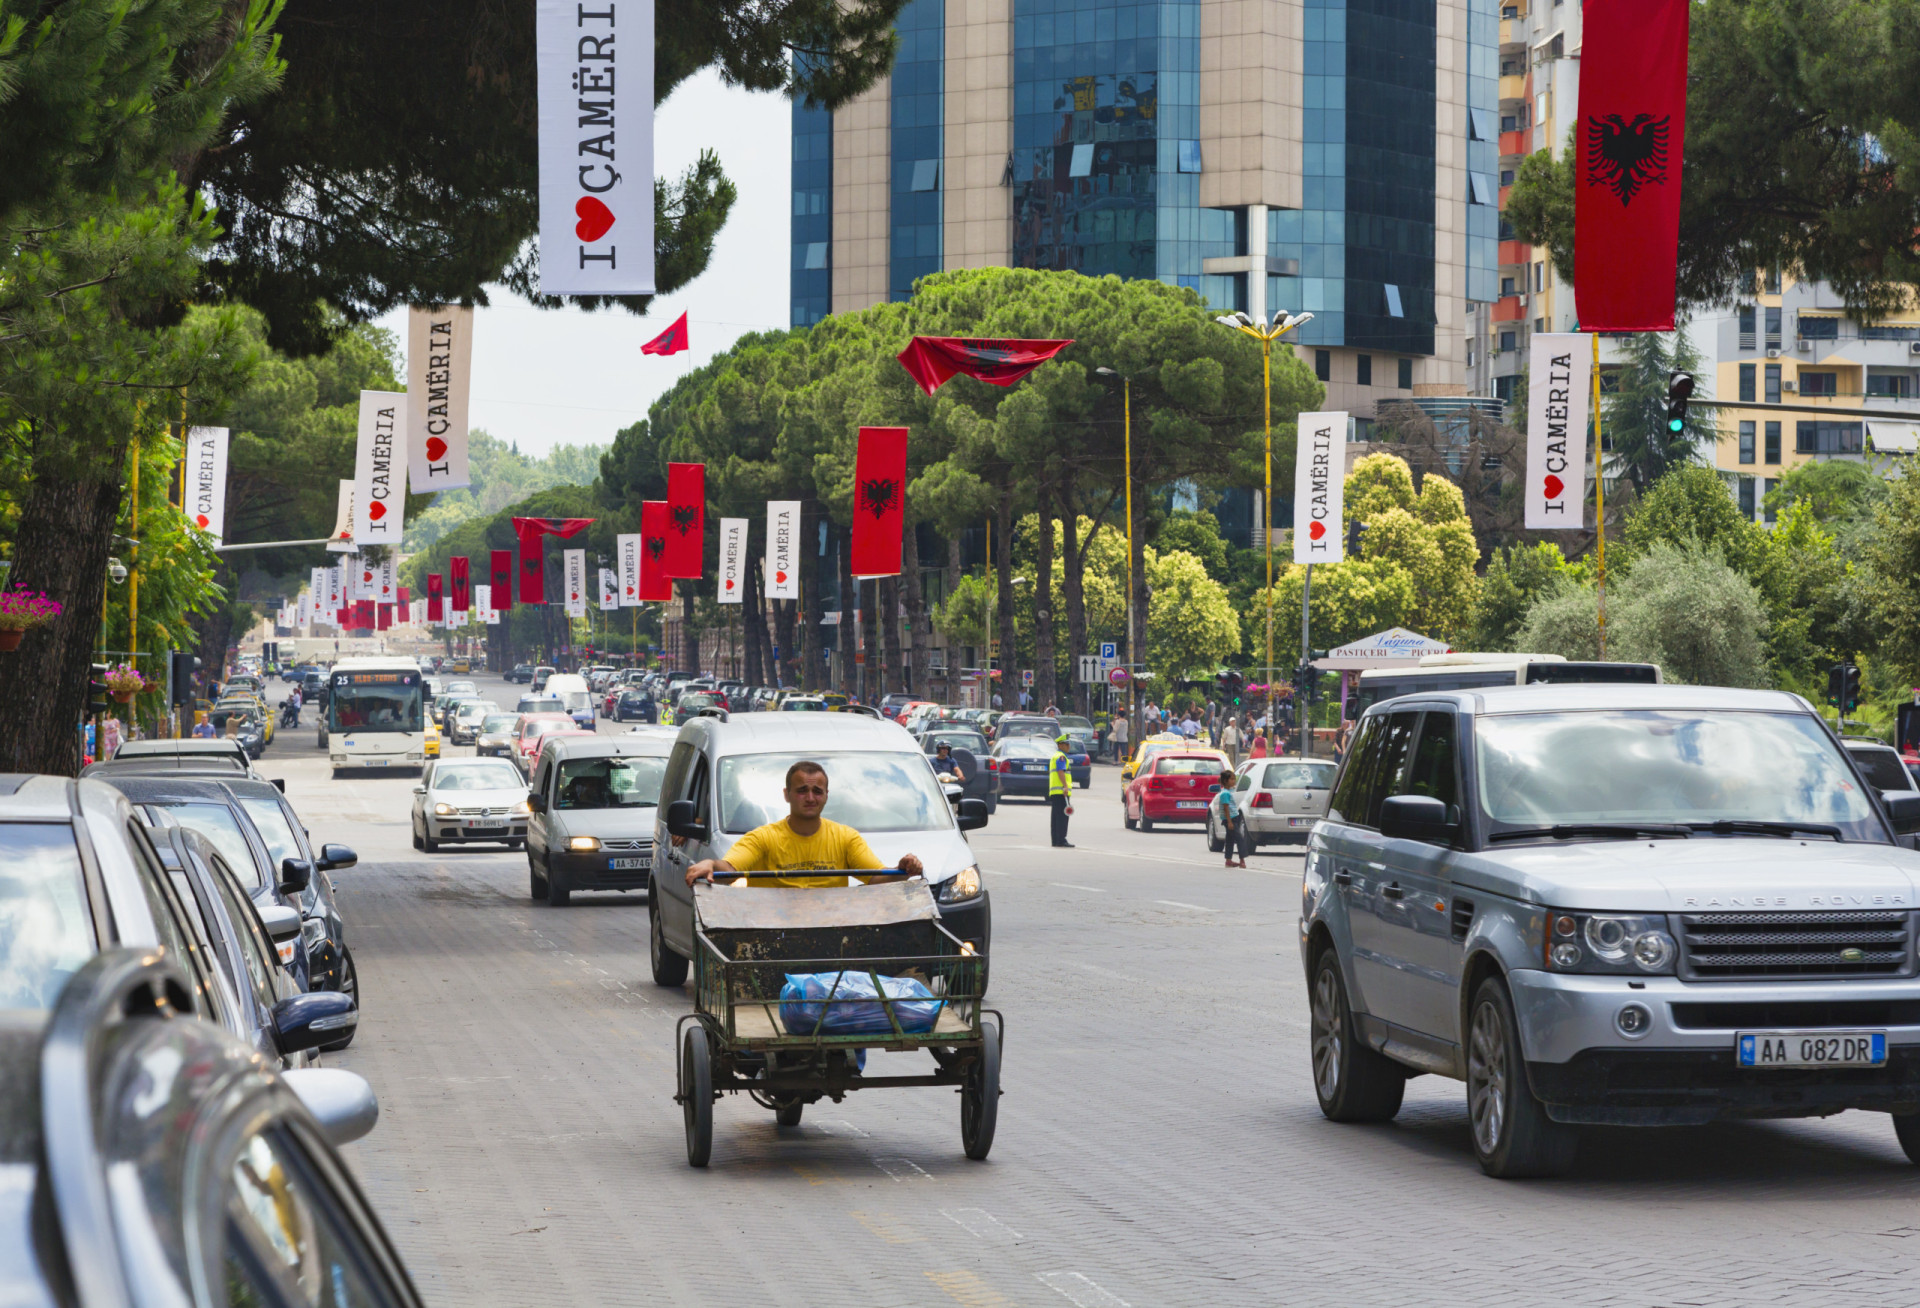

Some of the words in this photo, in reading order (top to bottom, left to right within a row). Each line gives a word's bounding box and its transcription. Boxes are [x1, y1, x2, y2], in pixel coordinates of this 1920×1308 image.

[580, 245, 616, 270] I
[425, 320, 452, 436] ÇAMËRIA
[1545, 352, 1571, 473] ÇAMËRIA
[372, 406, 395, 500] ÇAMËRIA
[198, 439, 215, 514] ÇAMËRIA
[428, 461, 449, 478] I
[1310, 426, 1331, 520] ÇAMËRIA
[1545, 501, 1564, 514] I
[370, 521, 386, 532] I
[776, 510, 790, 571] ÇAMËRIA
[1311, 541, 1327, 552] I
[726, 589, 735, 597] I
[776, 584, 788, 592] I
[1374, 634, 1426, 649] Laguna
[1105, 646, 1112, 657] P
[1336, 649, 1387, 659] PASTIÇERI
[337, 677, 348, 685] 25
[616, 860, 626, 868] AA
[1685, 897, 1787, 907] RANGE
[1810, 894, 1905, 906] ROVER
[1761, 1039, 1787, 1062] AA
